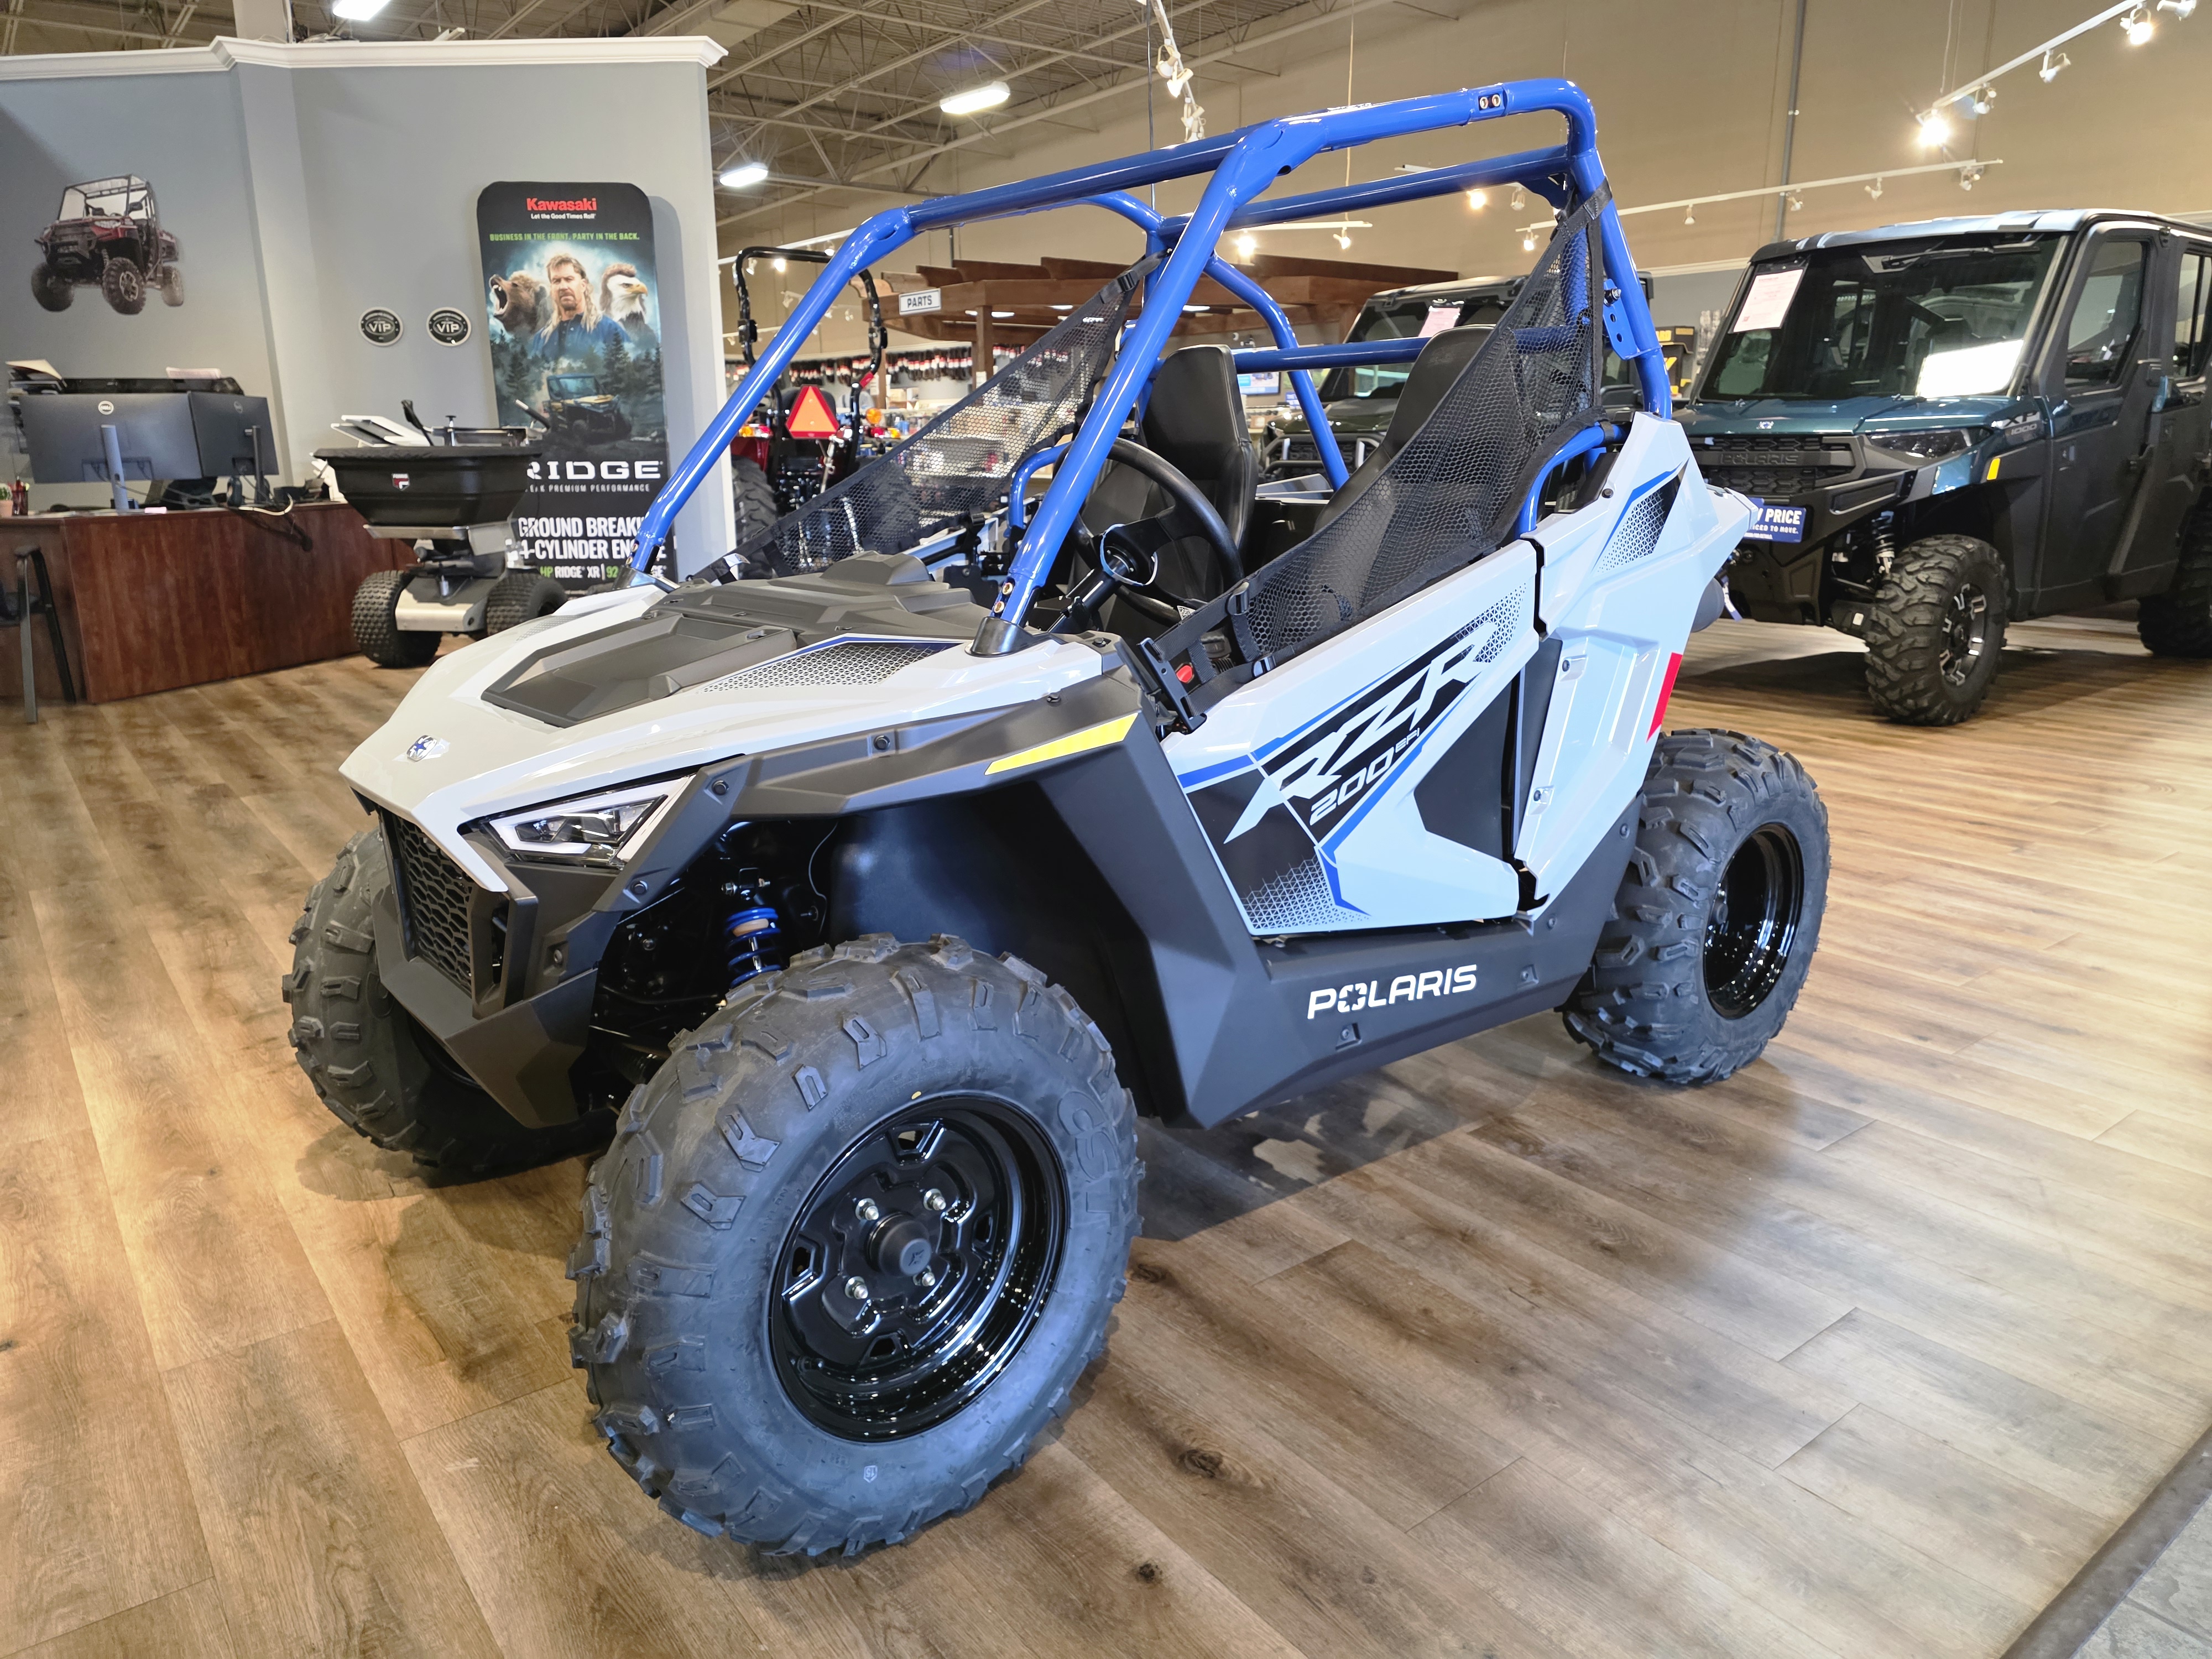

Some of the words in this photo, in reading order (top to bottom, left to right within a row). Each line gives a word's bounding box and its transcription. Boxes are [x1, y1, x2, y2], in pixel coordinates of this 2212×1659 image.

[526, 197, 597, 211] Kawasaki
[572, 232, 594, 241] PARTY
[619, 232, 640, 241] BACK.
[907, 295, 932, 309] PARTS
[368, 323, 391, 332] VIP
[436, 323, 460, 333] VIP
[2004, 410, 2037, 427] XP
[2011, 423, 2037, 435] 1000
[1720, 453, 1799, 465] POLARIS
[549, 484, 587, 493] PREMIUM
[590, 483, 650, 492] PERFORMANCE
[1765, 508, 1802, 525] PRICE
[518, 517, 583, 537] GROUND
[586, 566, 601, 578] XR
[606, 566, 619, 578] 92
[1224, 619, 1500, 844] RZR
[1307, 964, 1477, 1020] POLARIS
